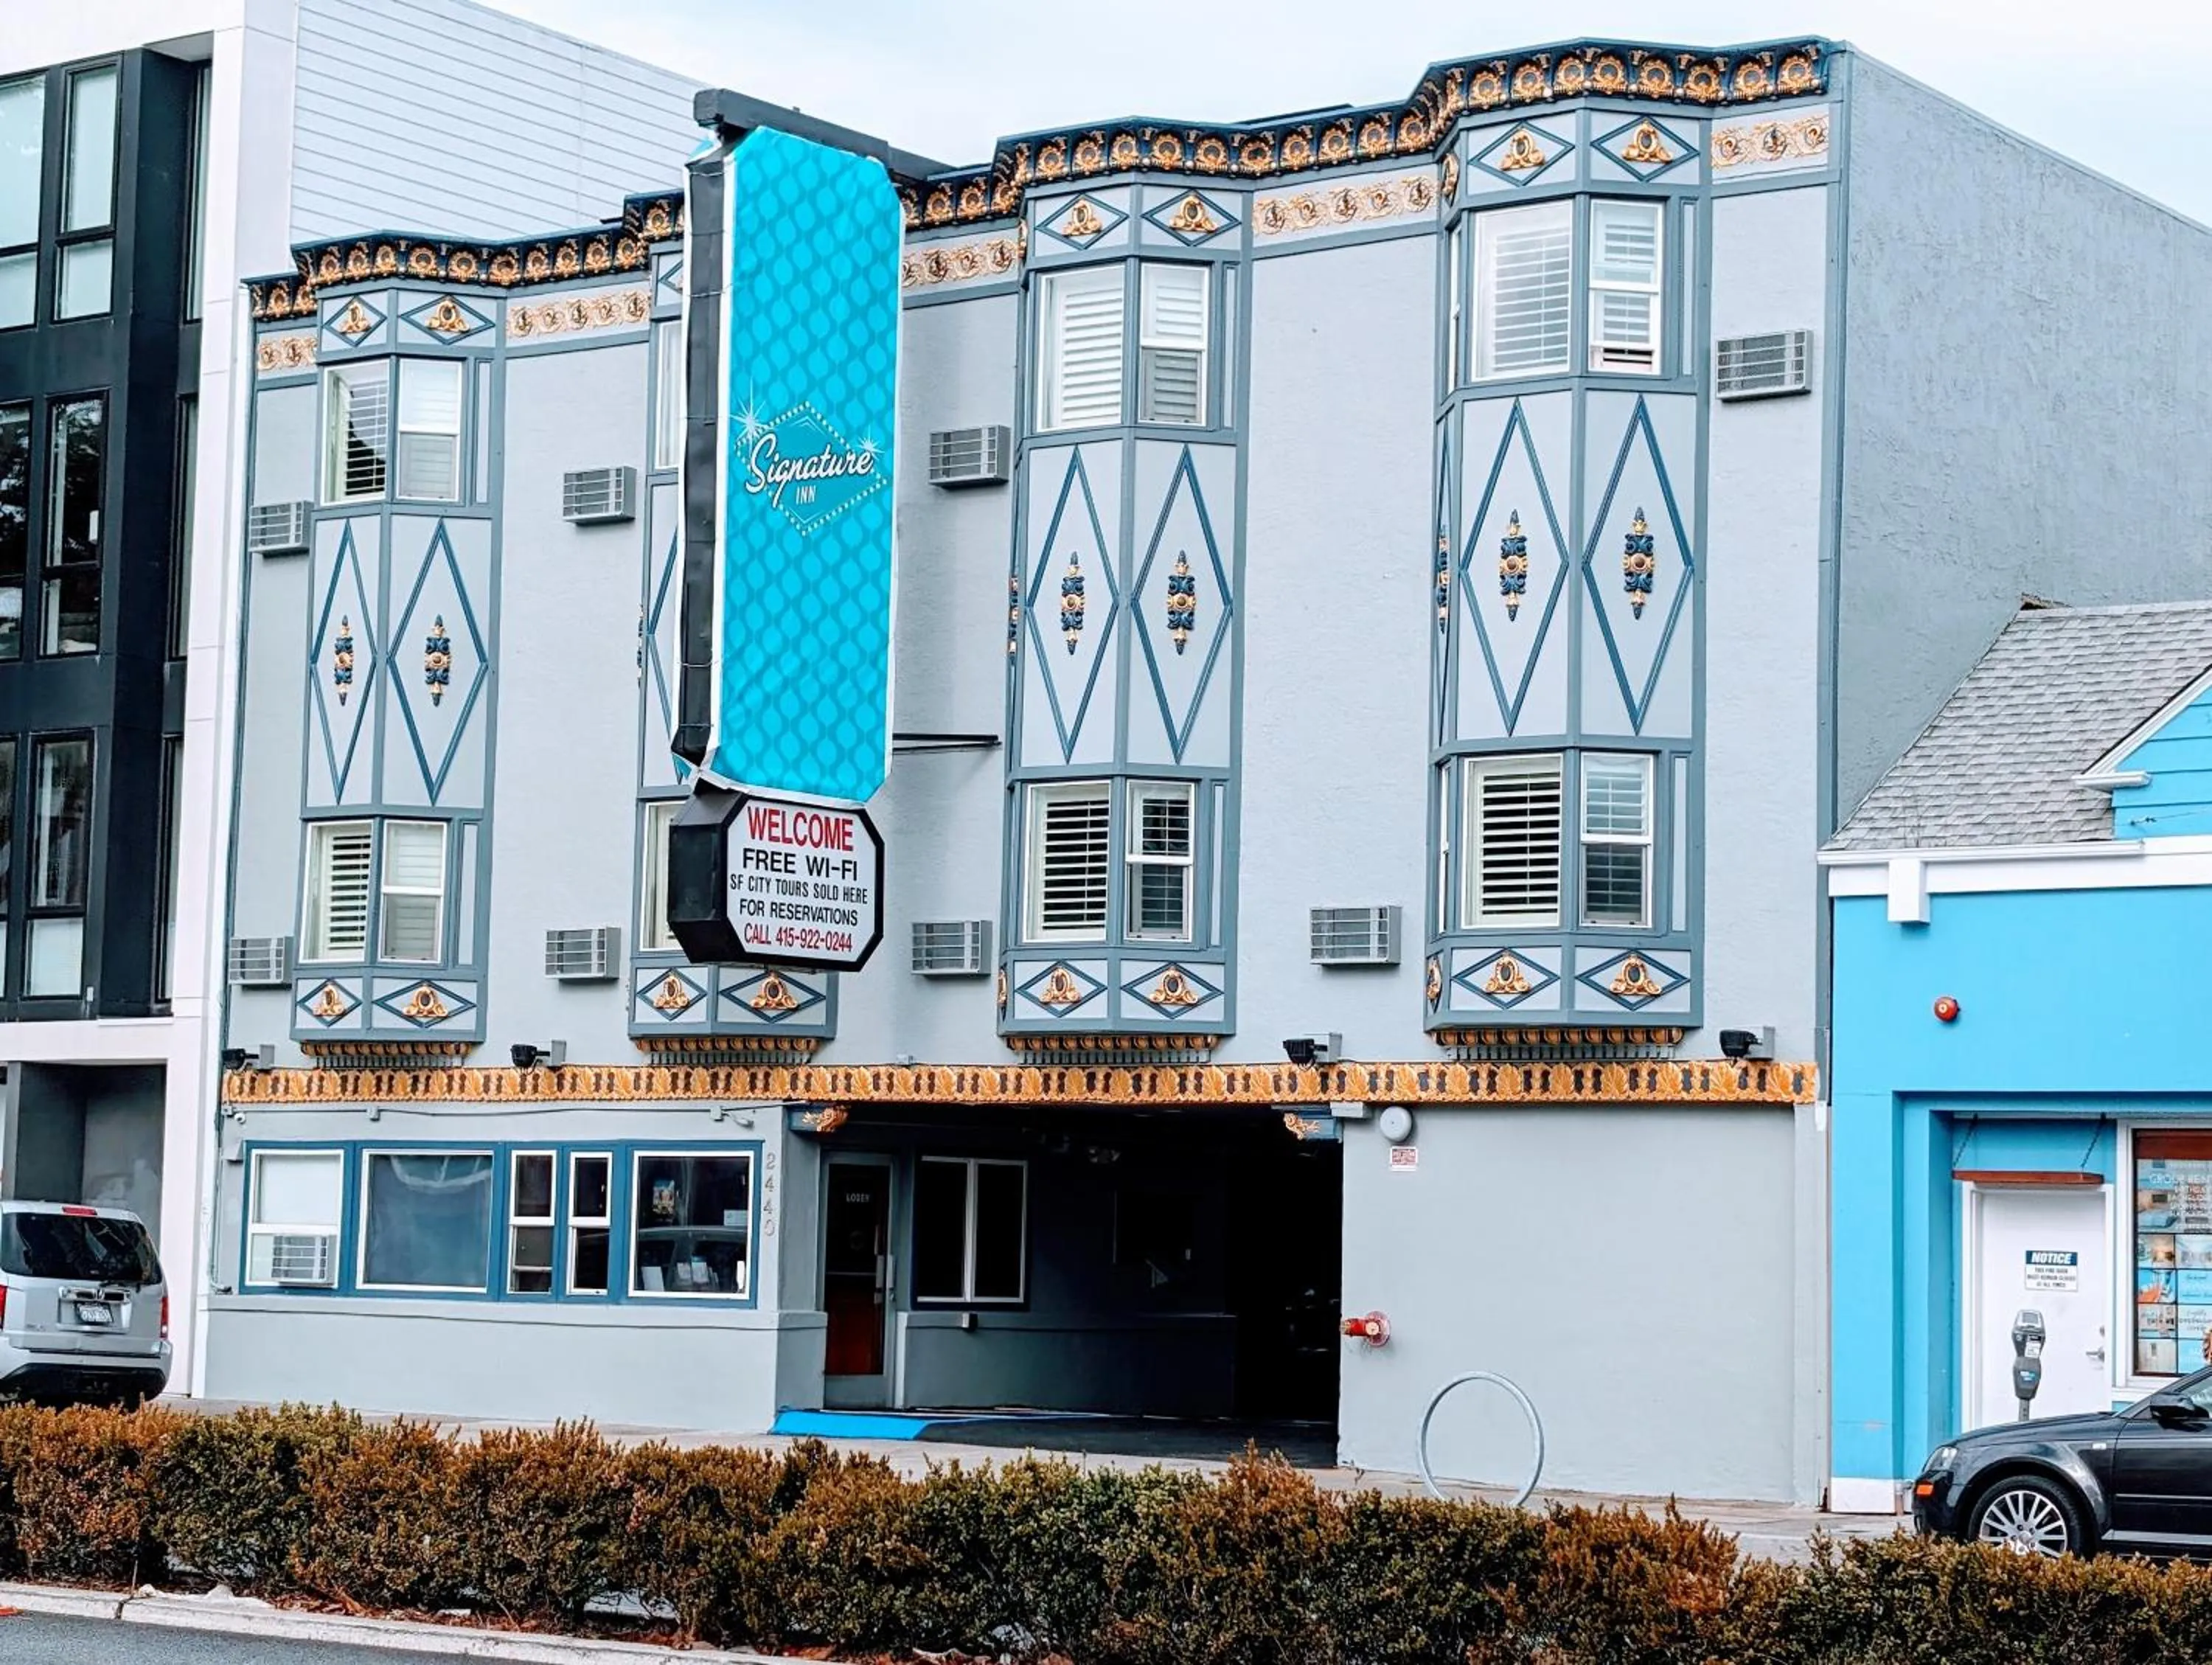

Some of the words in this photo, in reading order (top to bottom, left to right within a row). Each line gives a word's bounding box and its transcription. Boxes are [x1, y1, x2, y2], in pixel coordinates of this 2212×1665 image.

[746, 433, 874, 507] Signature
[796, 485, 816, 505] INN
[747, 806, 854, 852] WELCOME
[742, 848, 796, 874] FREE
[806, 855, 858, 881] WI-FI
[730, 874, 744, 890] SF
[748, 875, 771, 892] CITY
[776, 879, 809, 897] TOURS
[813, 883, 838, 902] SOLD
[843, 888, 868, 905] HERE
[740, 899, 765, 917] FOR
[771, 902, 858, 926] RESERVATIONS
[744, 923, 771, 945] CALL
[776, 927, 852, 953] 415-922-0244
[2031, 1251, 2073, 1265] NOTICE
